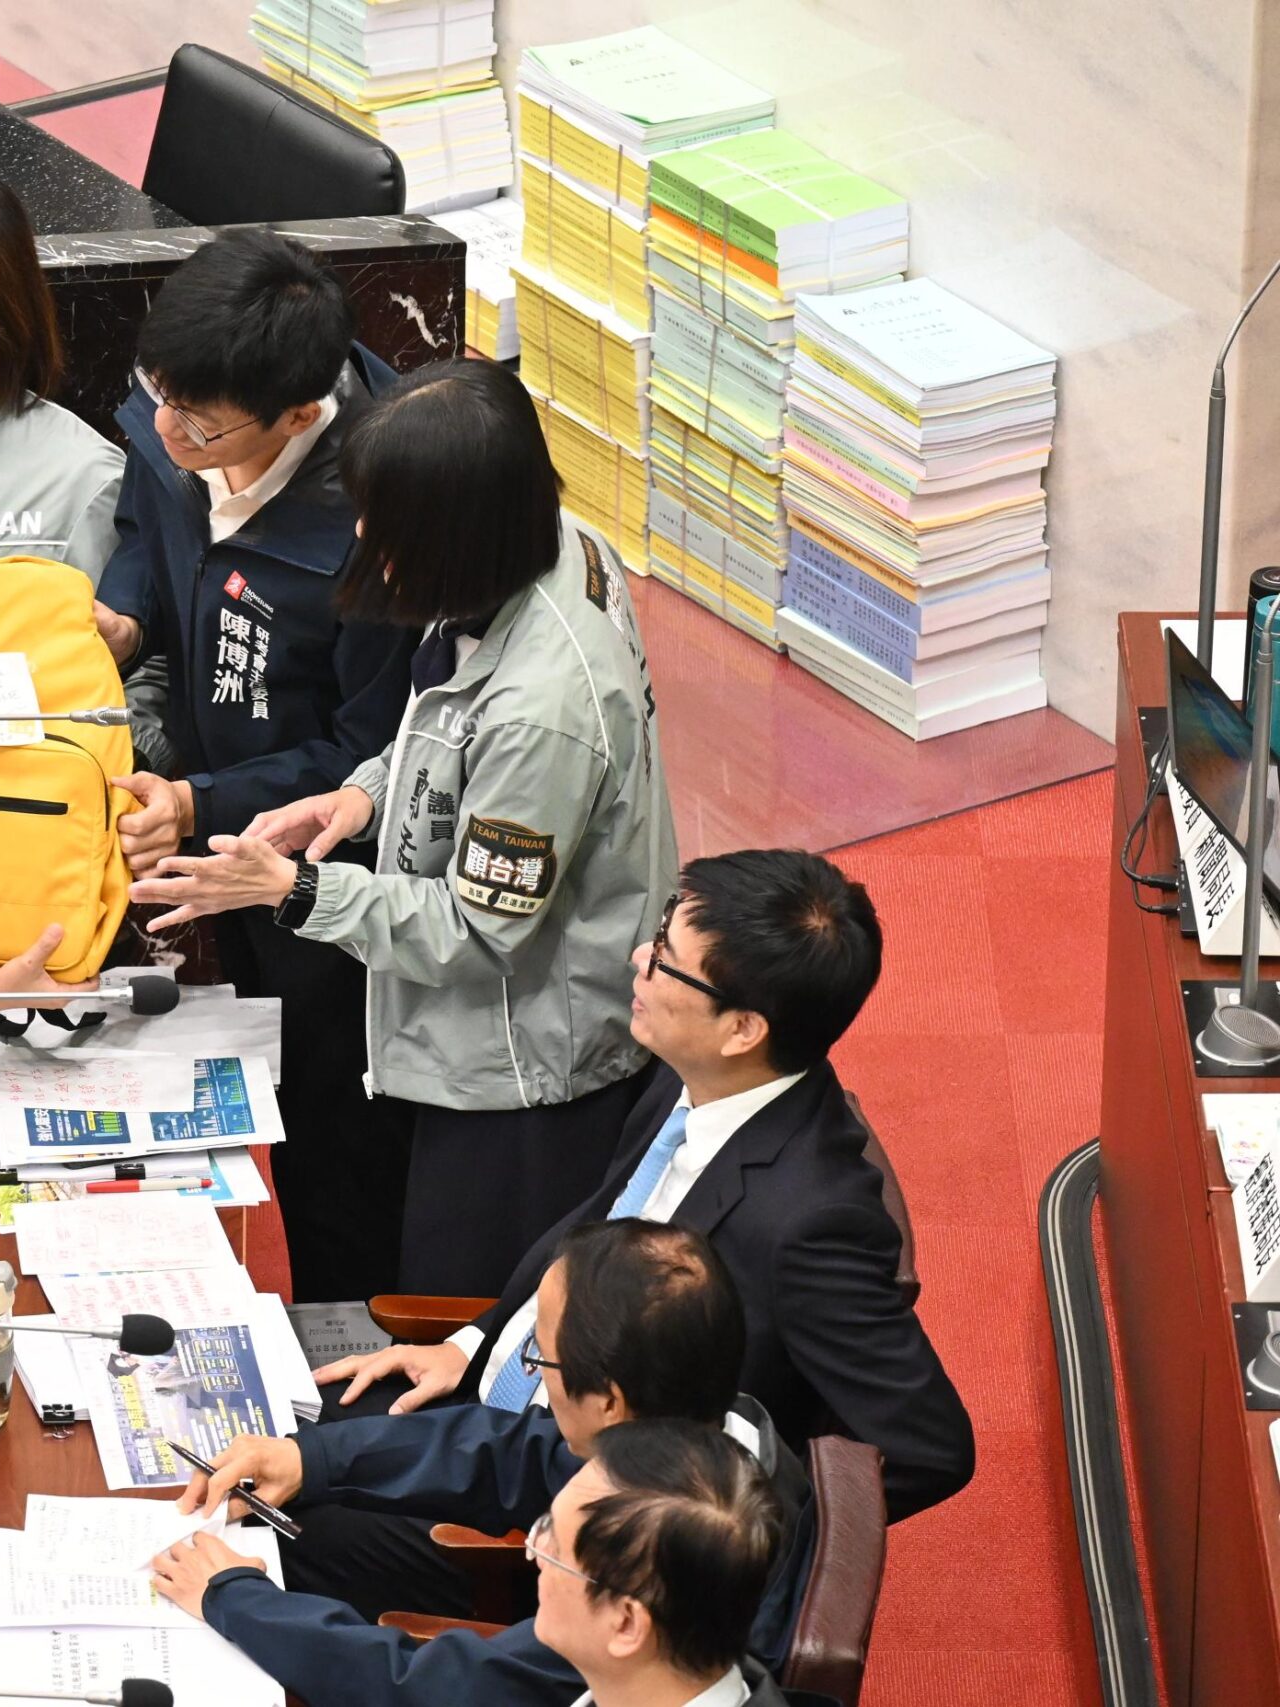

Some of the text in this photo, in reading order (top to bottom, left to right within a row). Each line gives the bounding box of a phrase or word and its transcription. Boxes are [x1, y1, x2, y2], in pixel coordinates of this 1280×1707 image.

[212, 607, 251, 703] 陳博洲
[248, 624, 270, 720] 研考會主委員
[427, 788, 456, 843] 議員
[472, 821, 546, 849] TEAM TAIWAN
[464, 842, 543, 891] 顧台灣
